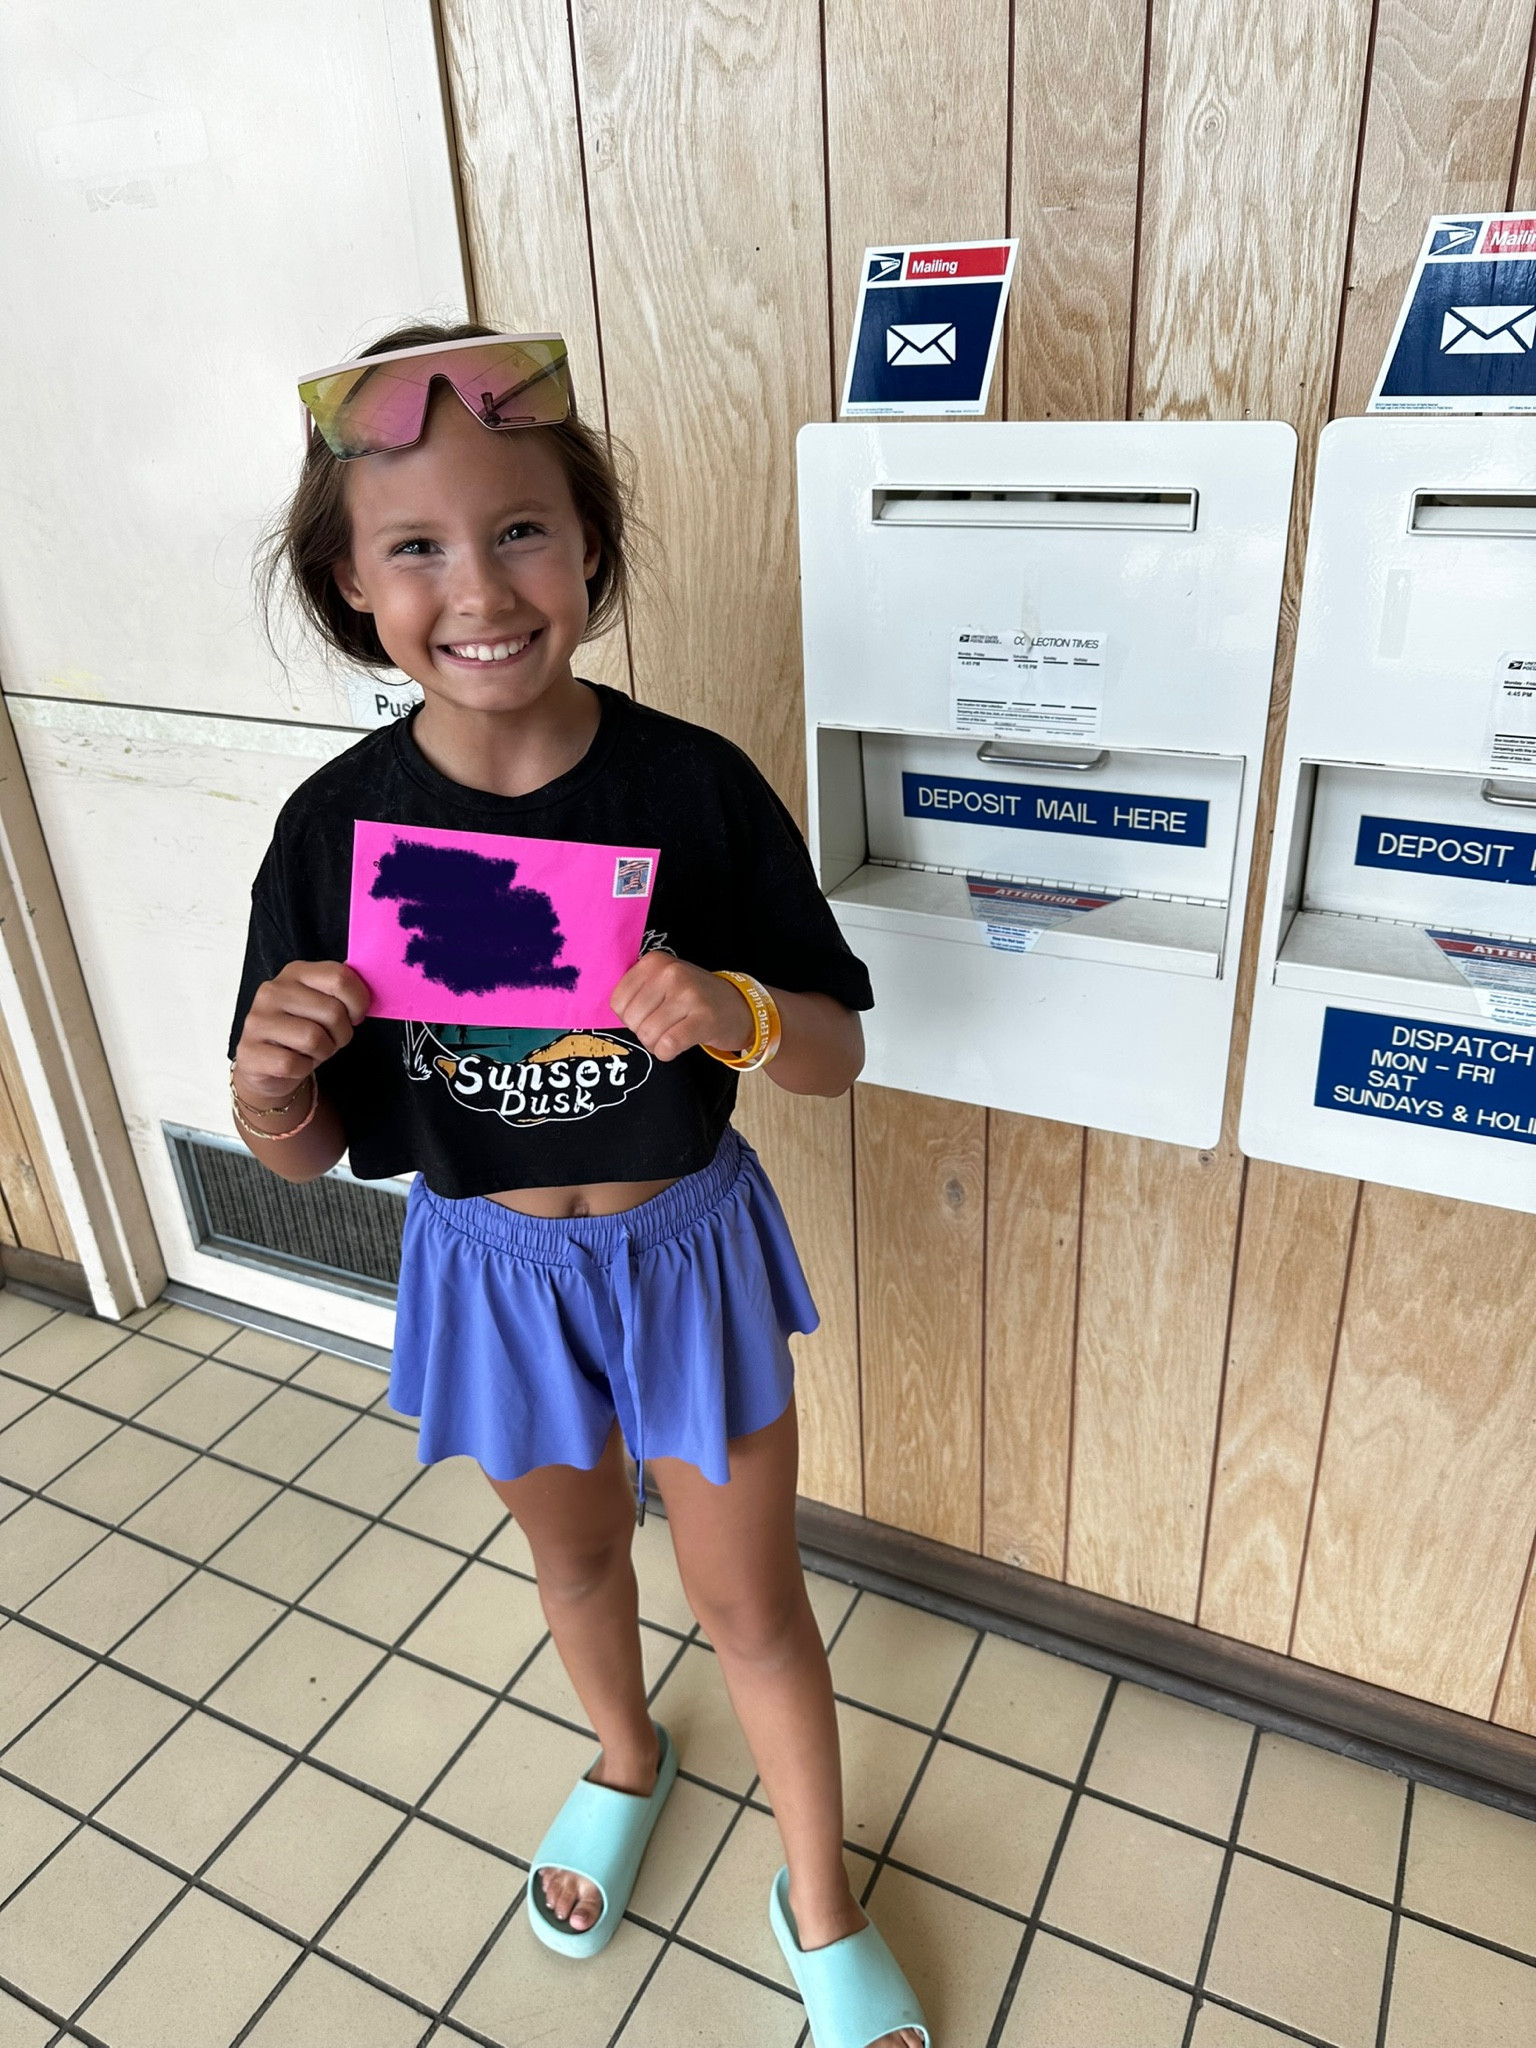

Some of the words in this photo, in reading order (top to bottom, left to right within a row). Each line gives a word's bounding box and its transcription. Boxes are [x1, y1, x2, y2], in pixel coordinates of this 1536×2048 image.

[911, 259, 958, 274] Mailing
[1072, 639, 1100, 649] TIMES
[375, 694, 416, 718] Pus
[918, 787, 1021, 816] DEPOSIT
[1036, 798, 1097, 824] MAIL
[1114, 806, 1187, 834] HERE
[1377, 832, 1514, 868] DEPOSIT
[994, 888, 1078, 904] ATTENTION
[747, 988, 764, 1007] kid!
[758, 1008, 770, 1035] EPIC
[1391, 1026, 1533, 1066] DISPATCH
[454, 1053, 629, 1094] Sunset
[1367, 1070, 1418, 1092] SAT
[1370, 1050, 1428, 1074] MON
[1457, 1062, 1495, 1086] FRI
[500, 1085, 596, 1117] Dusk
[1333, 1085, 1444, 1119] SUNDAYS
[1452, 1104, 1468, 1123] &
